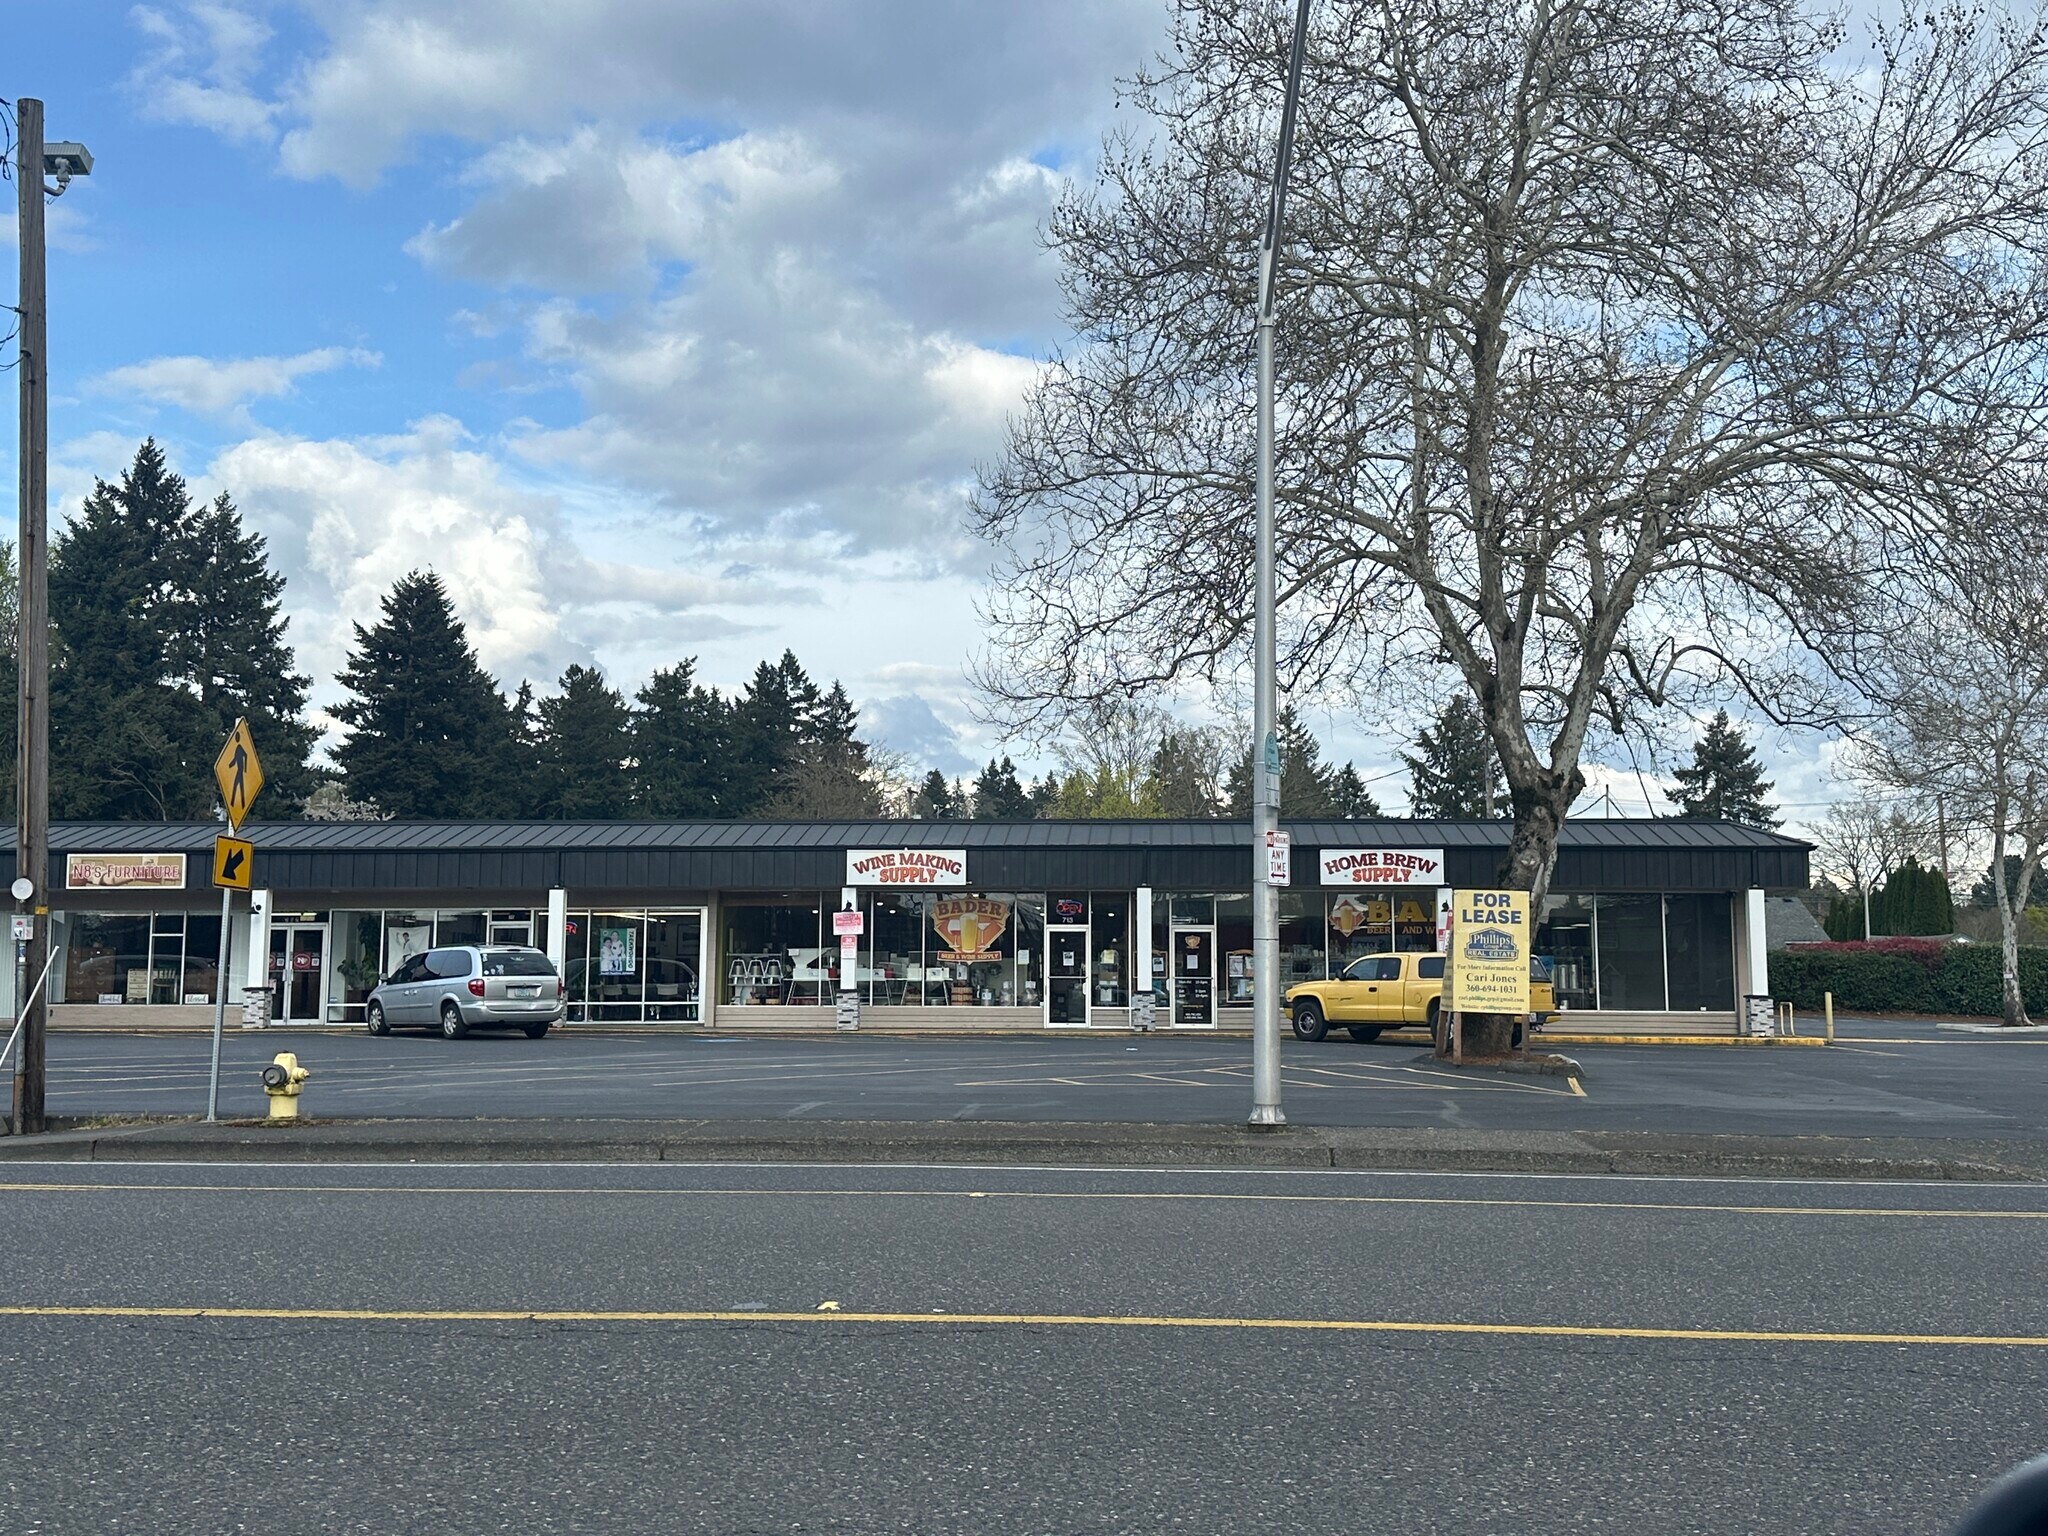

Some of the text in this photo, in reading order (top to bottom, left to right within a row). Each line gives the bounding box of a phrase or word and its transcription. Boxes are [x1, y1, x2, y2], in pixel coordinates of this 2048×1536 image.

[1272, 850, 1284, 860] ANY
[852, 853, 962, 875] WINE MAKING
[1271, 862, 1287, 872] TIME
[1324, 853, 1438, 874] HOME BREW
[73, 864, 180, 879] N8'S FURNITURE
[880, 867, 938, 882] SUPPLY
[1352, 868, 1412, 882] SUPPLY
[1473, 893, 1511, 907] FOR
[937, 901, 1002, 916] BADER
[1056, 902, 1082, 914] OPEN
[1462, 909, 1522, 924] LEASE
[1367, 926, 1391, 934] BEER
[1402, 926, 1423, 934] AND
[1473, 932, 1511, 946] Phillips
[1466, 973, 1517, 983] Cari Jones
[1466, 984, 1517, 994] 360-694-1031
